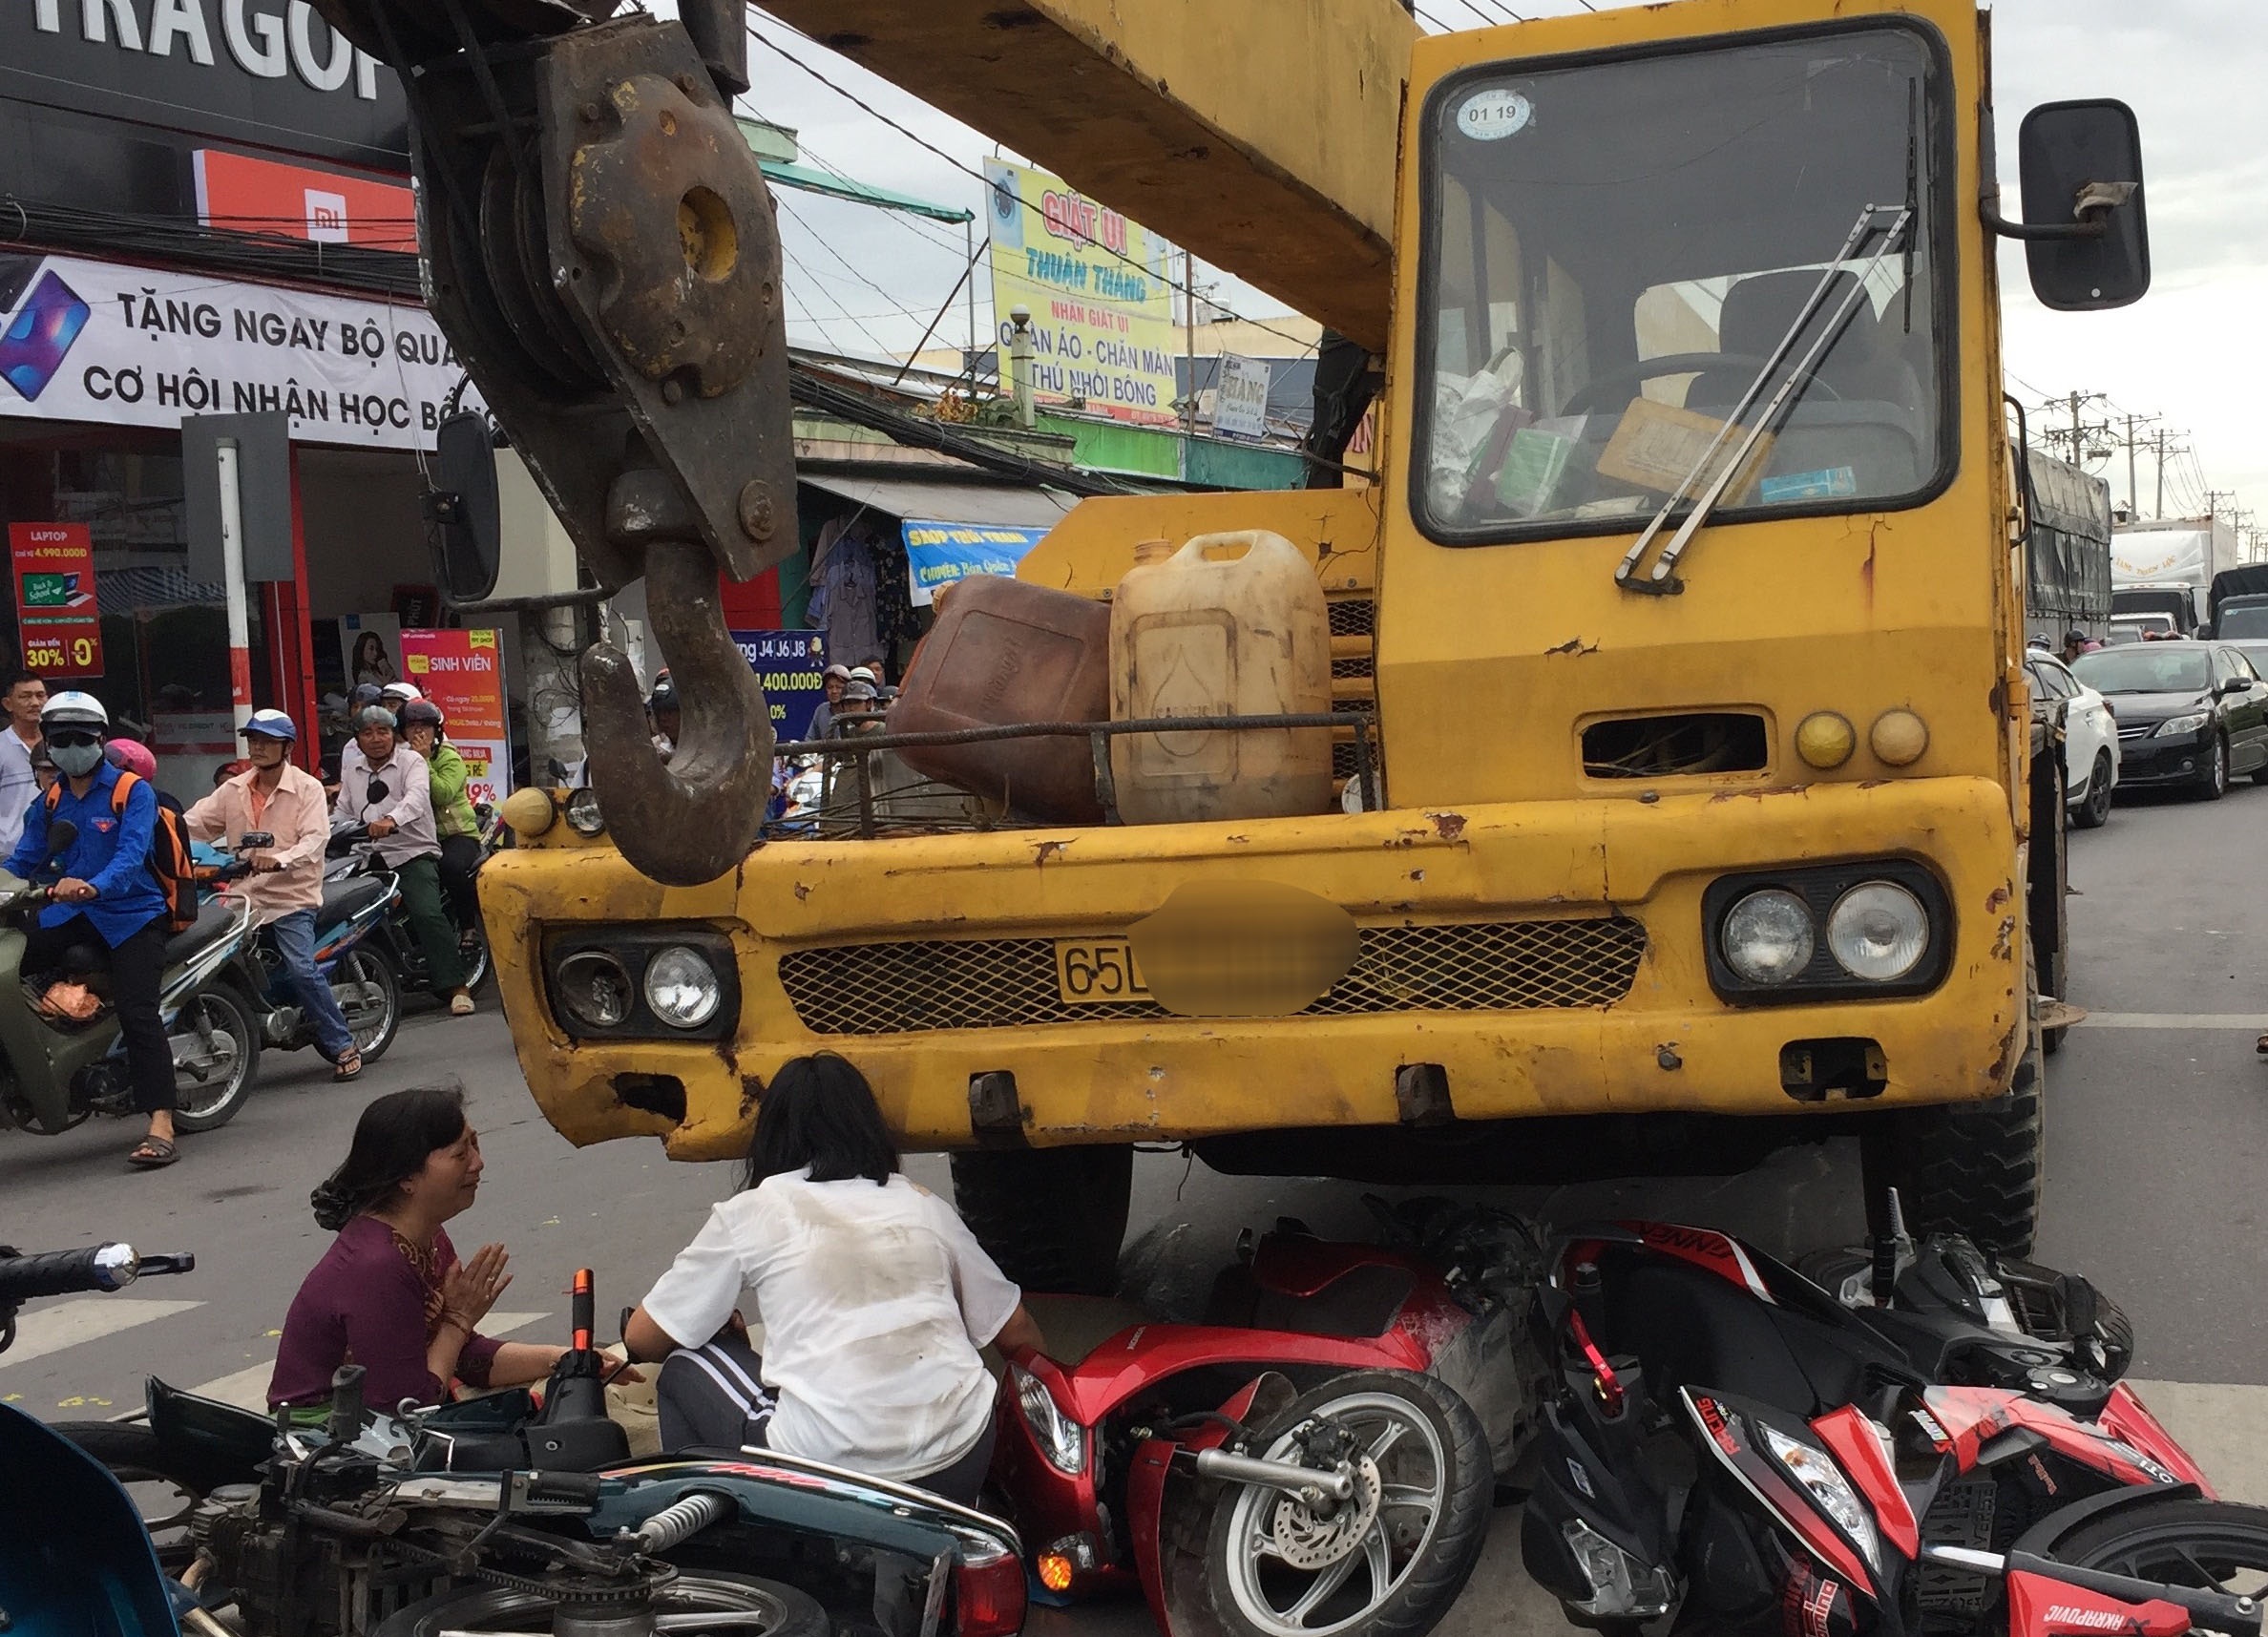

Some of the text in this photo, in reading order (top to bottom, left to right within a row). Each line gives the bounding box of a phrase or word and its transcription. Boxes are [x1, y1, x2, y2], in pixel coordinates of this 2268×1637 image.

[1469, 105, 1516, 122] 01 19
[1026, 246, 1087, 292] THUẬN
[116, 286, 221, 342] TẶNG
[234, 308, 328, 351] NGAY
[341, 318, 385, 368] BỘ
[999, 321, 1052, 354] QẦN
[1058, 325, 1082, 360] ÁO
[1096, 338, 1138, 370] CHĂN
[1143, 346, 1174, 377] MÀN
[83, 365, 144, 404] CƠ
[157, 367, 220, 415] HỘI
[232, 377, 329, 429] NHẬN
[339, 392, 410, 436] HỌC
[31, 532, 68, 541] LAPTOP
[27, 648, 65, 667] 30%
[430, 657, 460, 671] SINH
[461, 653, 491, 671] VIÊN
[769, 704, 787, 720] 0%
